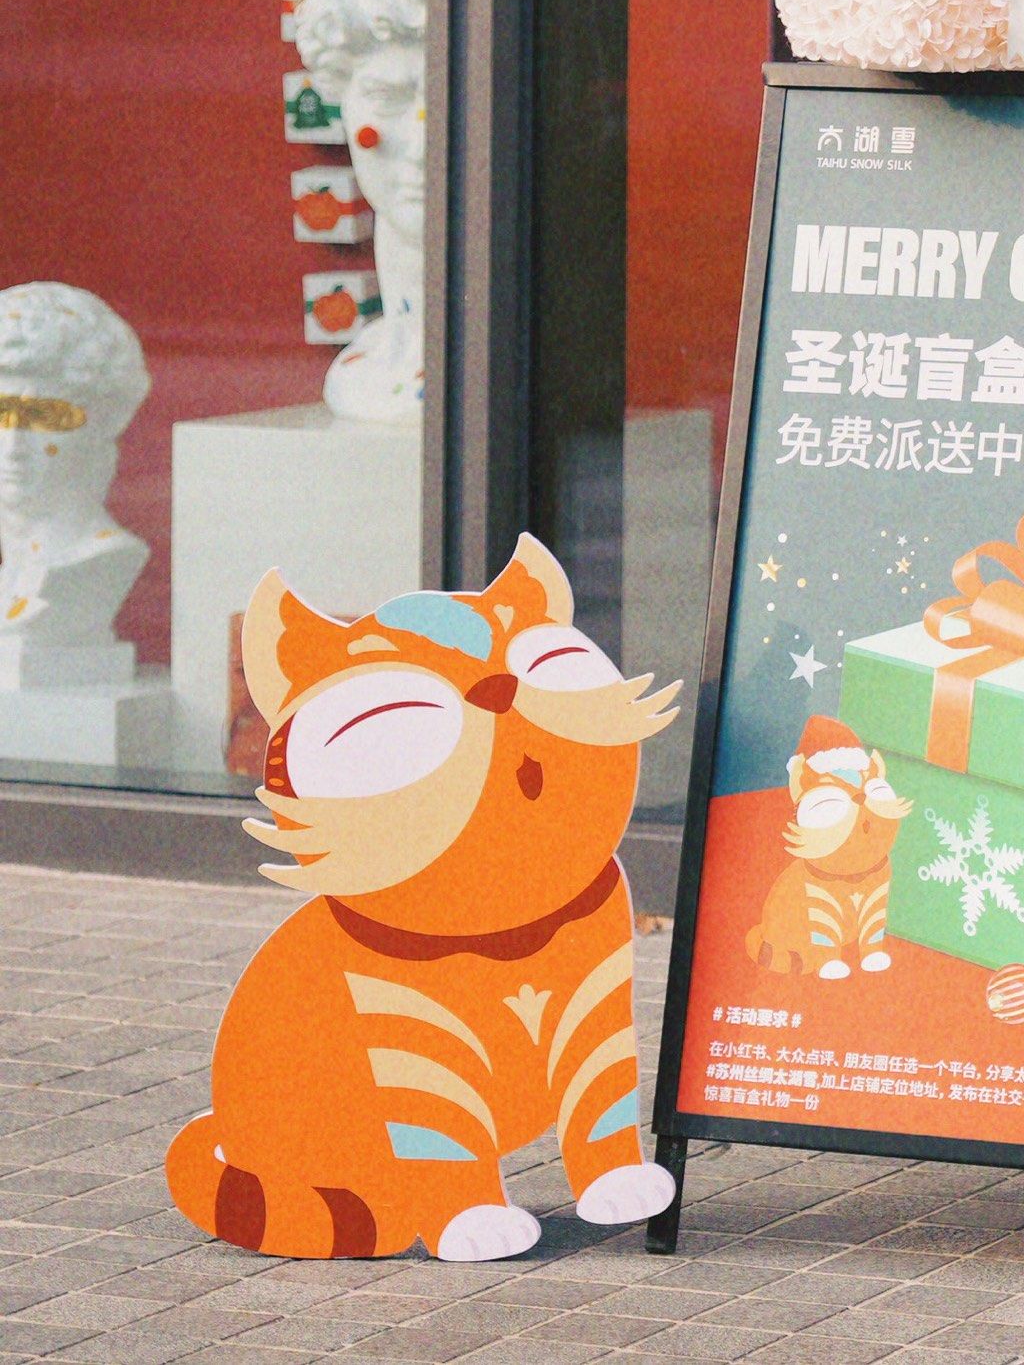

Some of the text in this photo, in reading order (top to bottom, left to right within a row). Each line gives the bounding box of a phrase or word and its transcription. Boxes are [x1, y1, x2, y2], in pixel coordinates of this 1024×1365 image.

[816, 157, 912, 171] TAIHU SNOW SILK
[791, 223, 1000, 300] MERRY
[775, 412, 1024, 477] 免费派送中
[726, 1006, 789, 1028] 活动要求
[704, 1084, 820, 1111] 惊喜盲盒礼物一份
